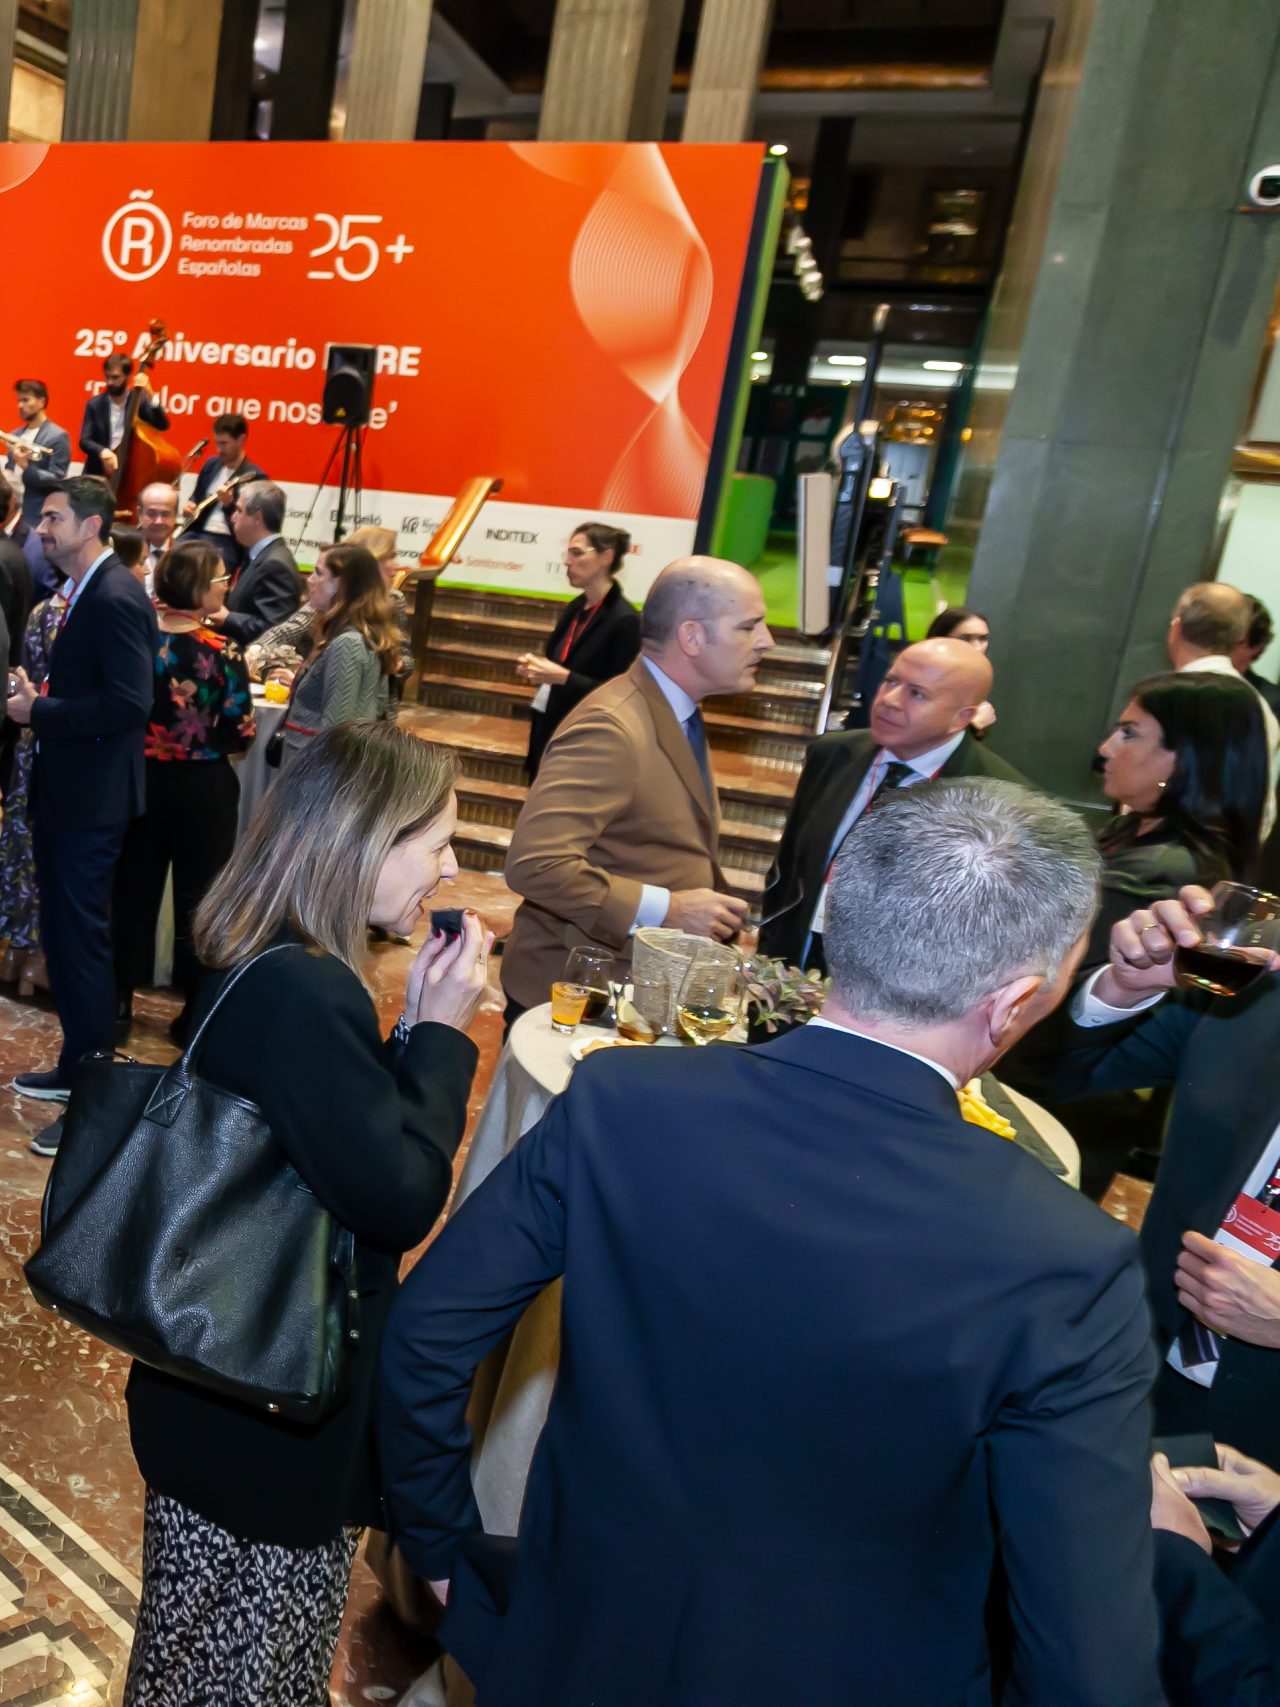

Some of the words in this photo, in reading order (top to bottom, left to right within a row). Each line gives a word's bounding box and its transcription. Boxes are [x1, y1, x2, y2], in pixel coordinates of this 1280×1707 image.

[182, 211, 220, 229] Foro
[220, 213, 244, 230] de
[245, 214, 308, 231] Marcas
[179, 235, 293, 255] Renombradas
[177, 257, 261, 278] Españolas
[132, 331, 317, 370] Aniversario
[267, 399, 323, 426] nos
[485, 528, 539, 545] INDITEX
[465, 555, 525, 573] Santander
